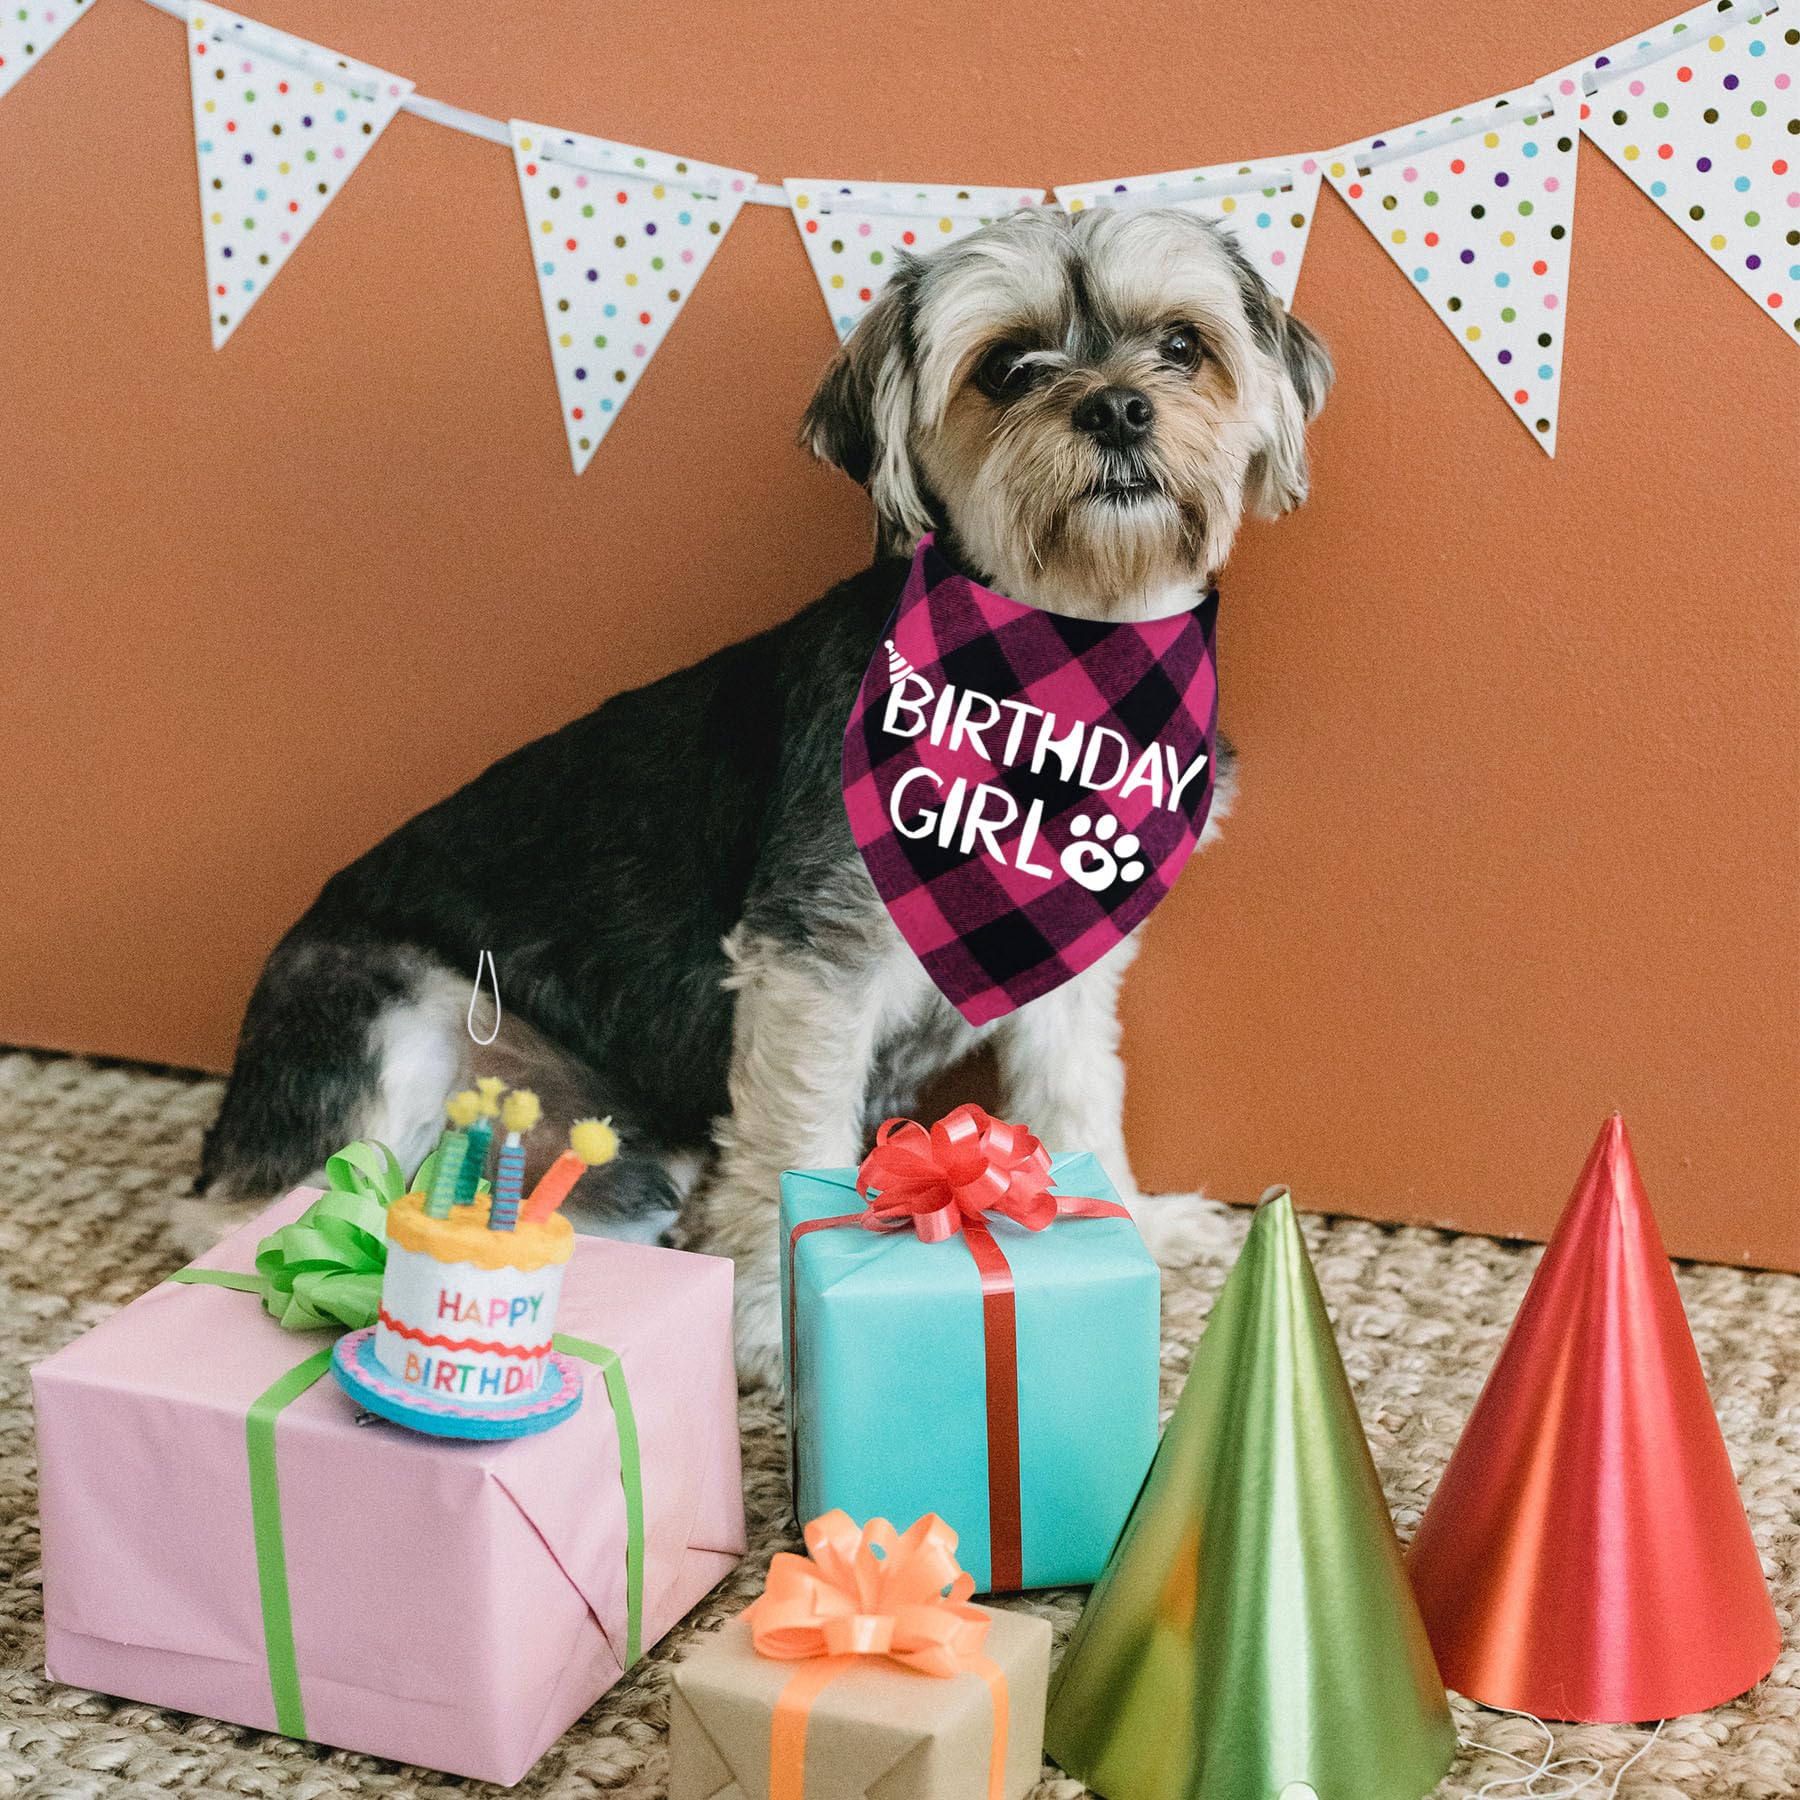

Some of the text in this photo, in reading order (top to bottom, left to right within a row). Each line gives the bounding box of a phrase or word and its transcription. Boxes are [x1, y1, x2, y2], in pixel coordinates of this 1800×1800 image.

[882, 673, 1208, 813] BIRTHDAY
[890, 767, 1053, 880] GIRL
[438, 1289, 544, 1327] HAPPY
